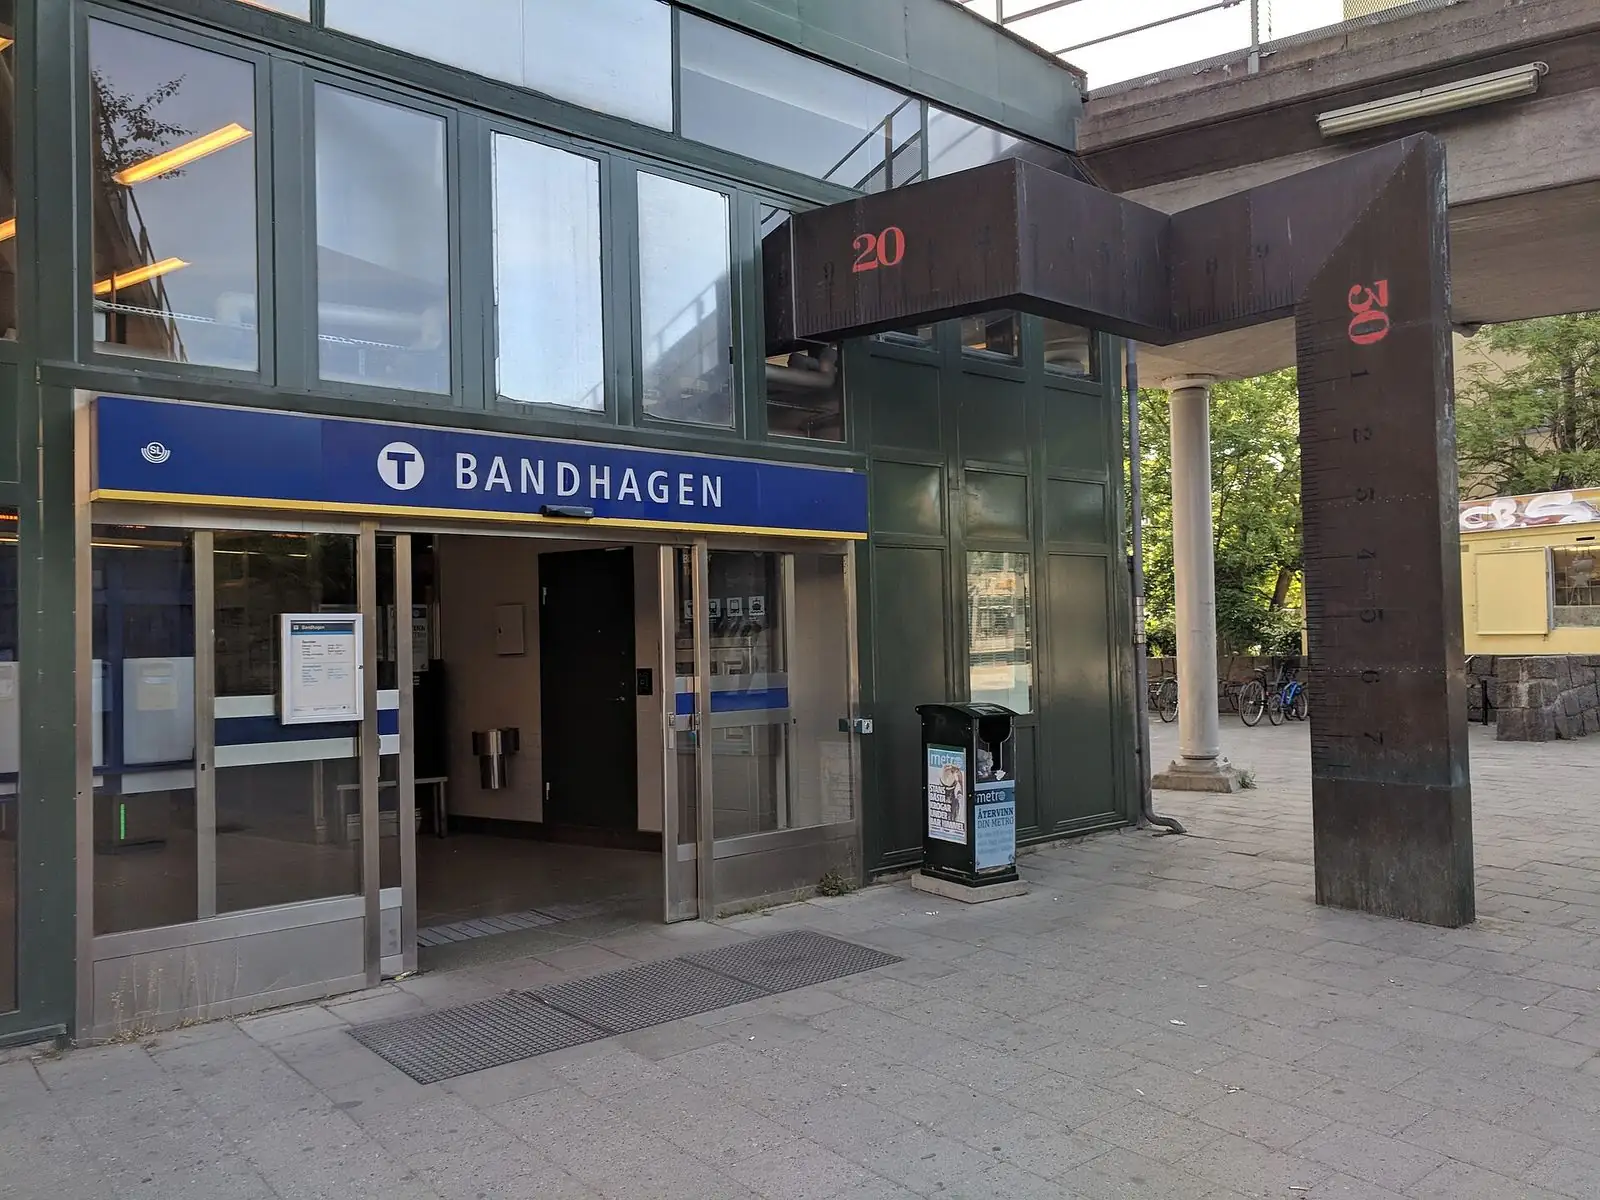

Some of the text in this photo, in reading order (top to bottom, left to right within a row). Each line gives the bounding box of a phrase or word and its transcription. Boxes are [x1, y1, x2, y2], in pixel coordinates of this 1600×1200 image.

[851, 225, 906, 274] 20
[1348, 279, 1390, 346] 30
[455, 452, 723, 508] BANDHAGEN
[976, 790, 1006, 804] metro
[977, 807, 1014, 820] ÅTERVINN
[977, 816, 1014, 829] DIN METRO
